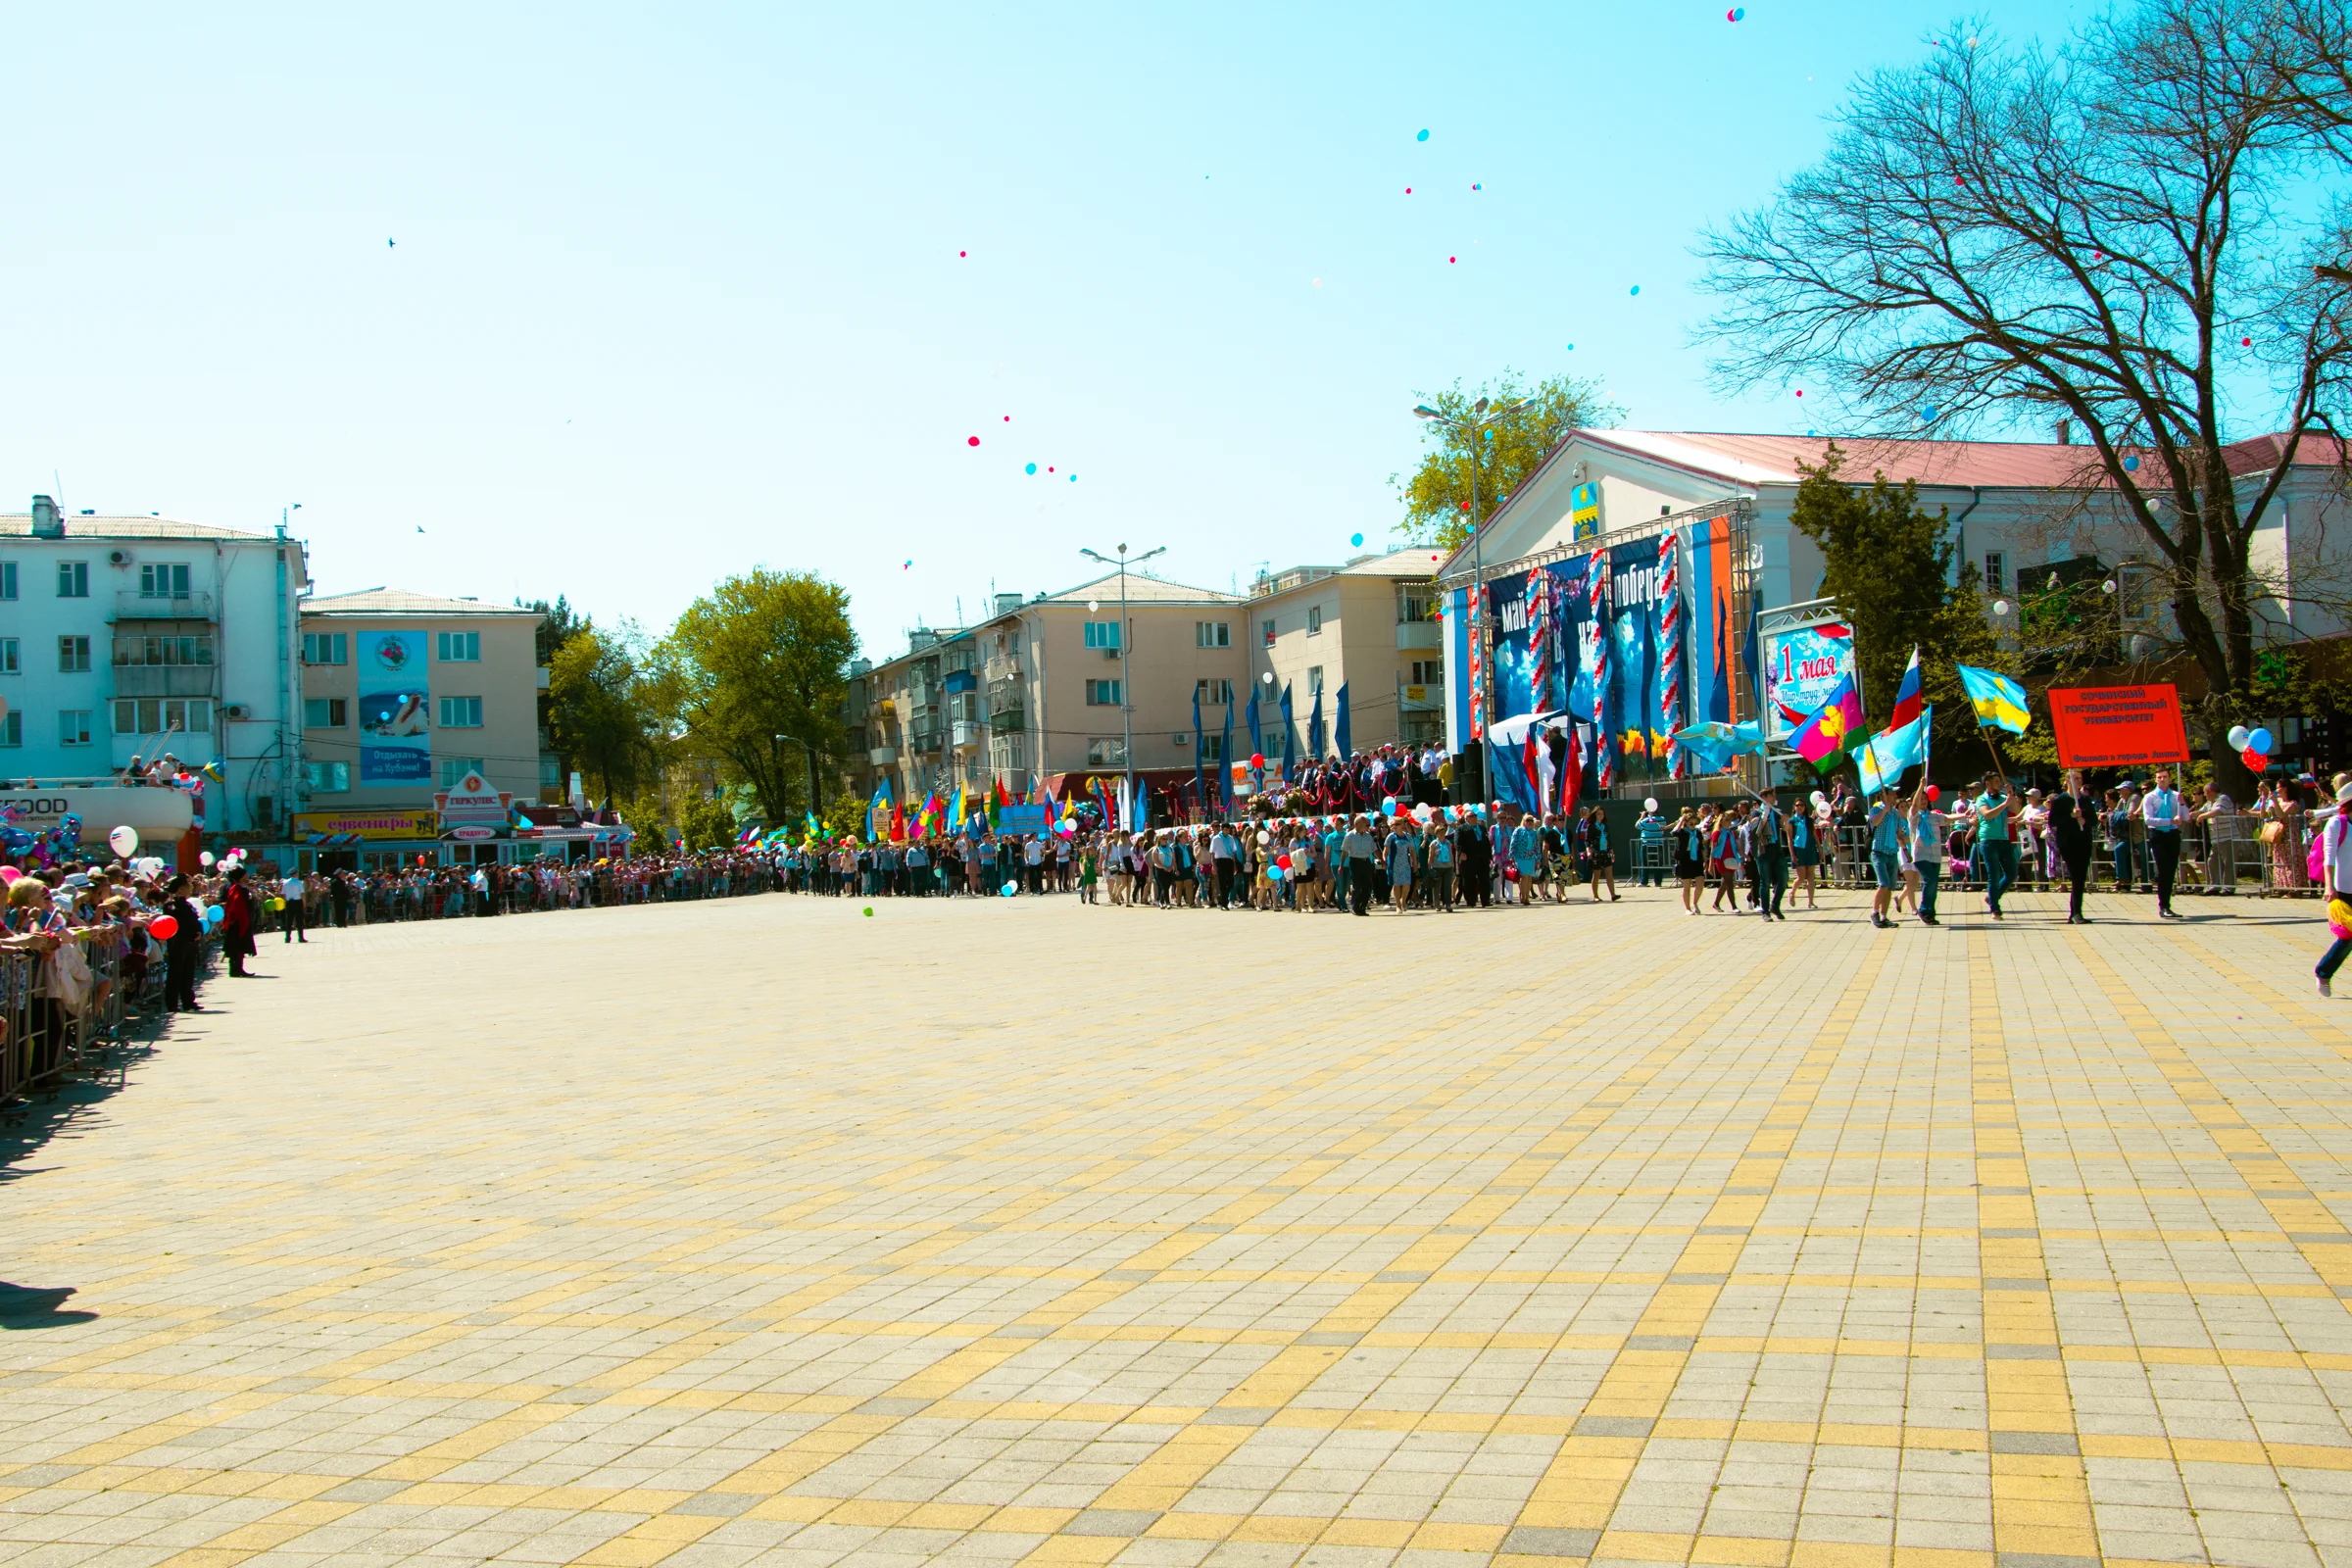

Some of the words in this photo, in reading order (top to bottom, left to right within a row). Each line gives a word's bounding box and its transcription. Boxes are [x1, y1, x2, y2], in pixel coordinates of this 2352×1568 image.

[1614, 564, 1663, 612] победа
[1501, 592, 1527, 633] май
[1782, 645, 1793, 682] 1
[1799, 656, 1838, 680] мая
[2259, 654, 2285, 681] 24
[1780, 690, 1798, 706] Мир,
[1799, 689, 1821, 705] труд,
[2080, 687, 2145, 701] СОЧИНСКИЙ
[2065, 699, 2167, 713] ГОСУДАРСТВЕННЫЙ
[2082, 713, 2154, 725] УНИВЕРСИТЕТ
[373, 750, 417, 760] Отдыхать
[2117, 753, 2147, 761] городе
[385, 763, 420, 774] Кубани!
[450, 797, 497, 806] ГЕРКУЛЕС
[327, 817, 414, 832] сувениры
